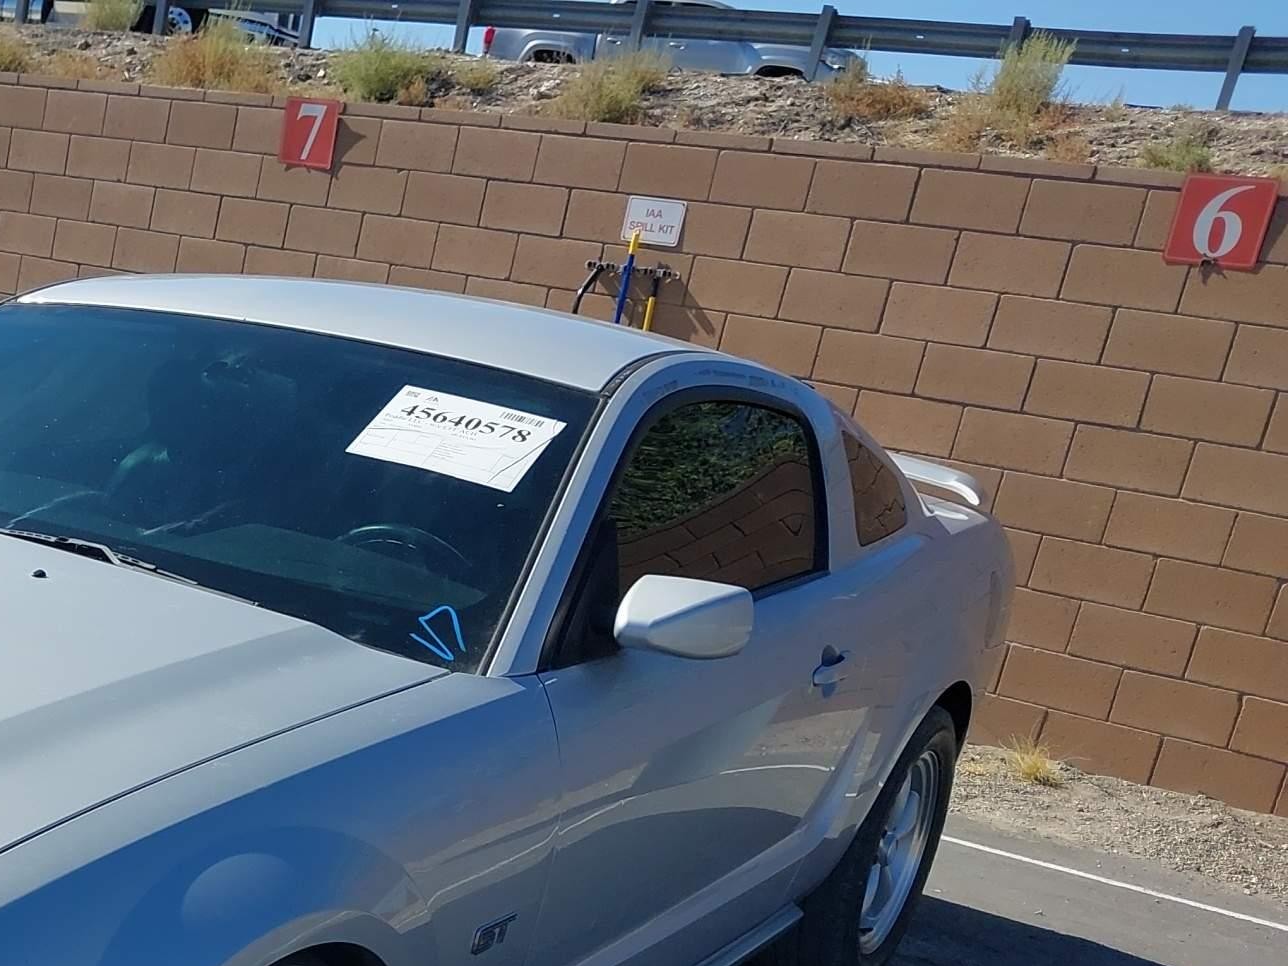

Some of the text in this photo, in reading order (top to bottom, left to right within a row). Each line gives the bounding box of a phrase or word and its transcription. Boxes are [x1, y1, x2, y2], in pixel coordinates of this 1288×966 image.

[296, 103, 328, 160] 7
[645, 208, 663, 218] IAA
[658, 224, 676, 235] KIT
[1193, 185, 1256, 258] 6
[400, 404, 532, 443] 45640578
[470, 911, 518, 955] GT
